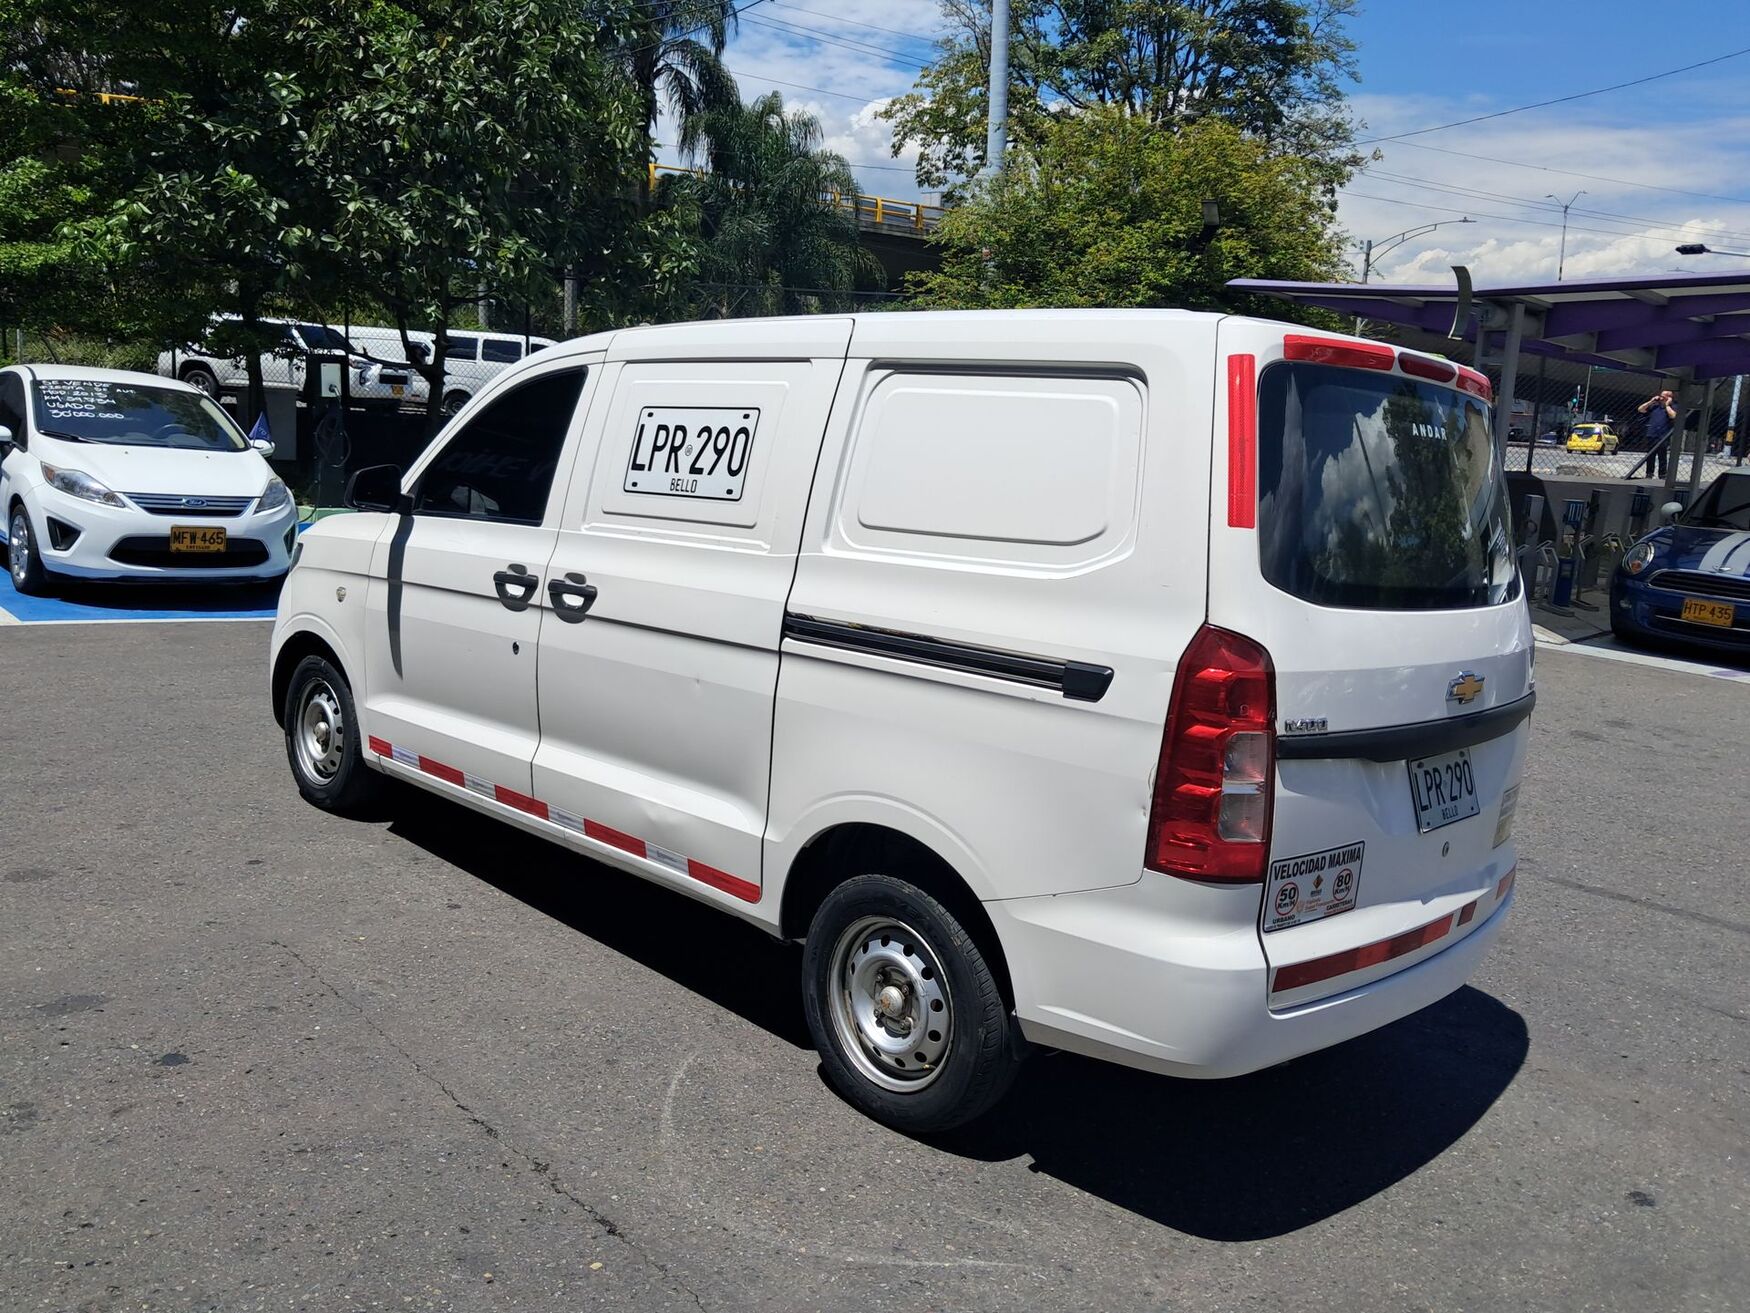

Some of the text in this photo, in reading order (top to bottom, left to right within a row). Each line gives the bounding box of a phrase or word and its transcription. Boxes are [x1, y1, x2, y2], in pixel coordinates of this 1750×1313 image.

[63, 380, 112, 388] VENDE
[46, 401, 96, 410] USADO
[1412, 422, 1448, 441] ANDAR
[631, 423, 750, 477] LPR 290
[669, 478, 698, 493] BELLO
[173, 531, 224, 545] MFW 465
[1683, 601, 1733, 621] HTP 435
[1414, 759, 1474, 812] LPR 290
[1441, 804, 1460, 821] BELLO
[1273, 846, 1361, 881] VELOCIDAD MAXIMA
[1336, 872, 1352, 888] 80
[1279, 886, 1297, 902] 50
[1272, 914, 1296, 925] URBANO
